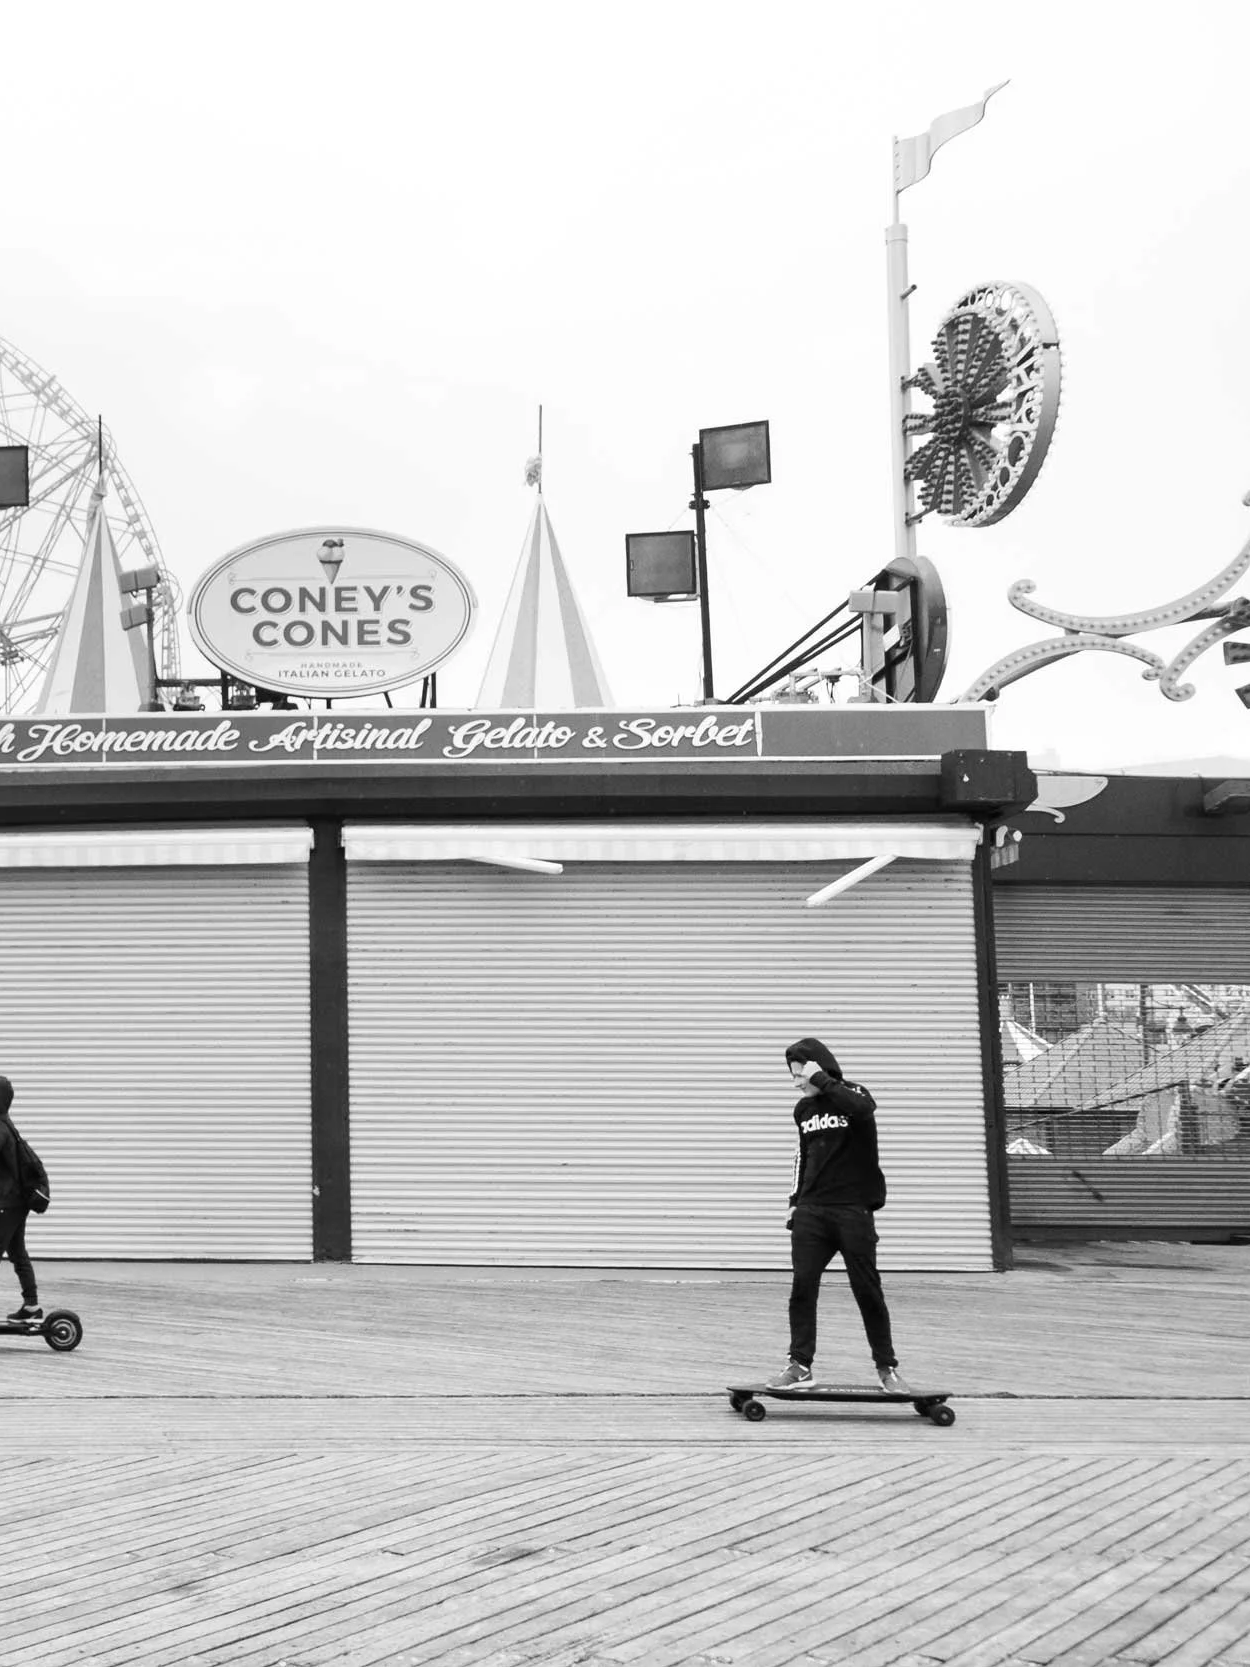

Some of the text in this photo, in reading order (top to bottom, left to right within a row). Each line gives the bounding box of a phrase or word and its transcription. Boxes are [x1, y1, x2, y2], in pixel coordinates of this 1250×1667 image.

[230, 584, 435, 614] CONEY'S
[252, 619, 412, 647] CONES
[278, 669, 386, 679] ITALIAN GELATO
[301, 661, 363, 669] HANDMADE
[17, 720, 240, 761] Homemade
[249, 716, 433, 753] Artisinal
[443, 717, 575, 758] Gelato
[582, 727, 608, 749] &
[612, 715, 754, 751] Sorbet
